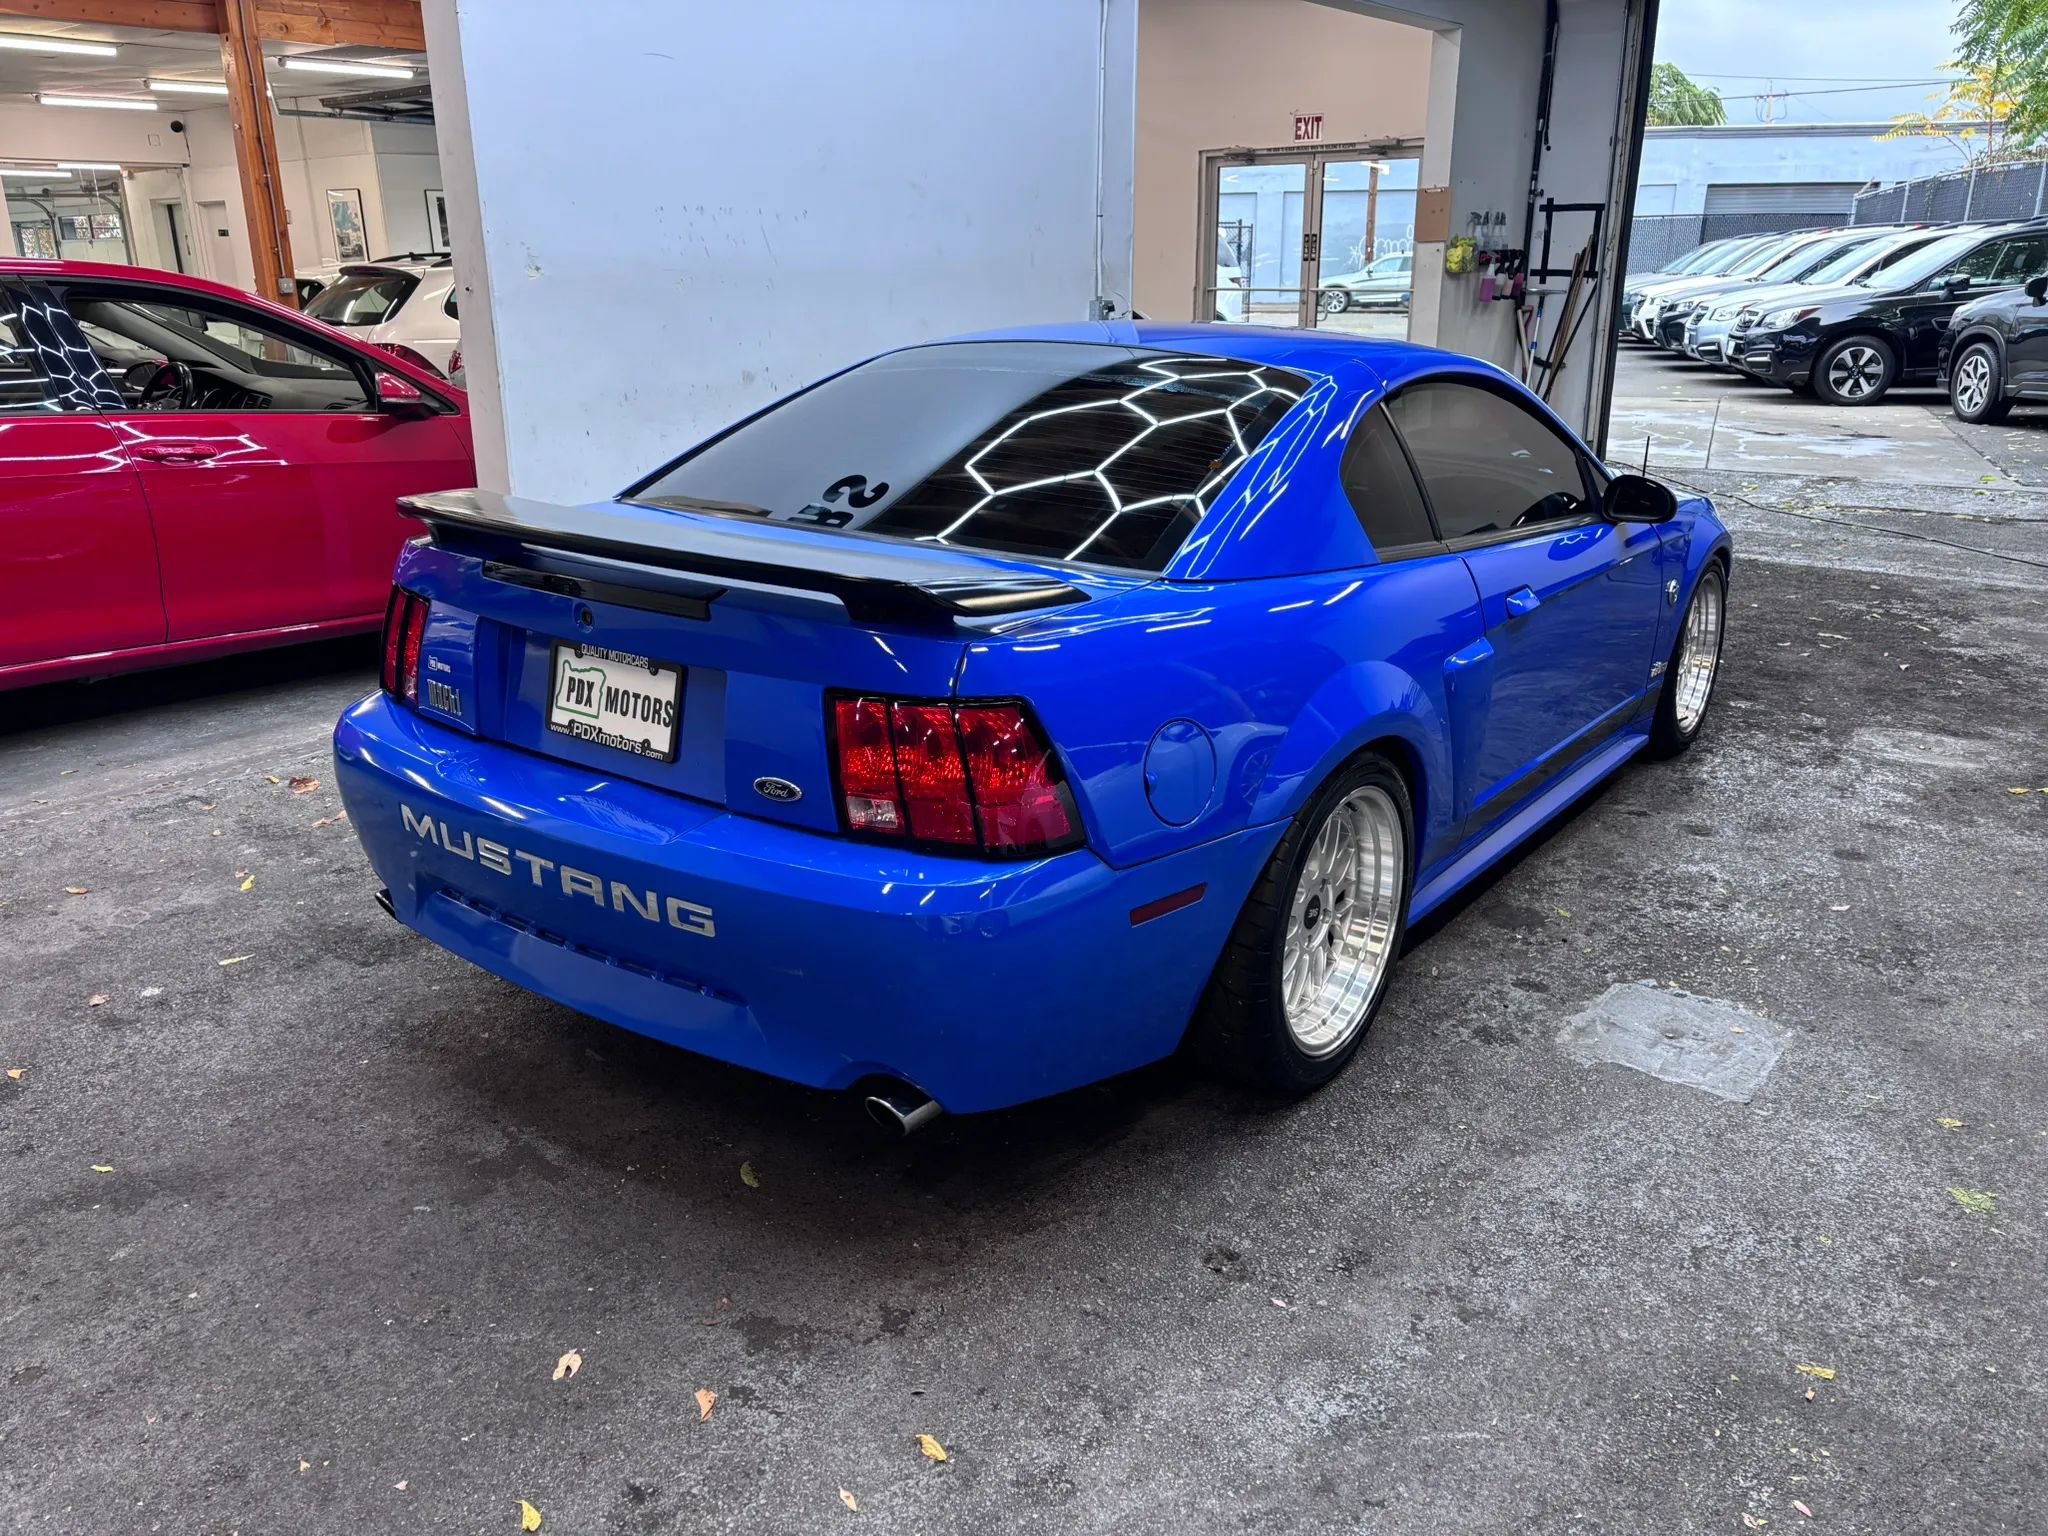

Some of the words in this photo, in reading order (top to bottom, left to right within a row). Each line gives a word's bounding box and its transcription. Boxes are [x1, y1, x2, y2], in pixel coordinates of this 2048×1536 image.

[1295, 116, 1323, 140] EXIT
[581, 643, 608, 658] QUALITY
[608, 650, 649, 669] MOTORCARS
[566, 676, 595, 708] PDX
[604, 686, 674, 728] MOTORS
[550, 722, 663, 760] www.PDXmotors.com
[763, 781, 789, 798] Ford
[400, 803, 716, 938] MUSTANG
